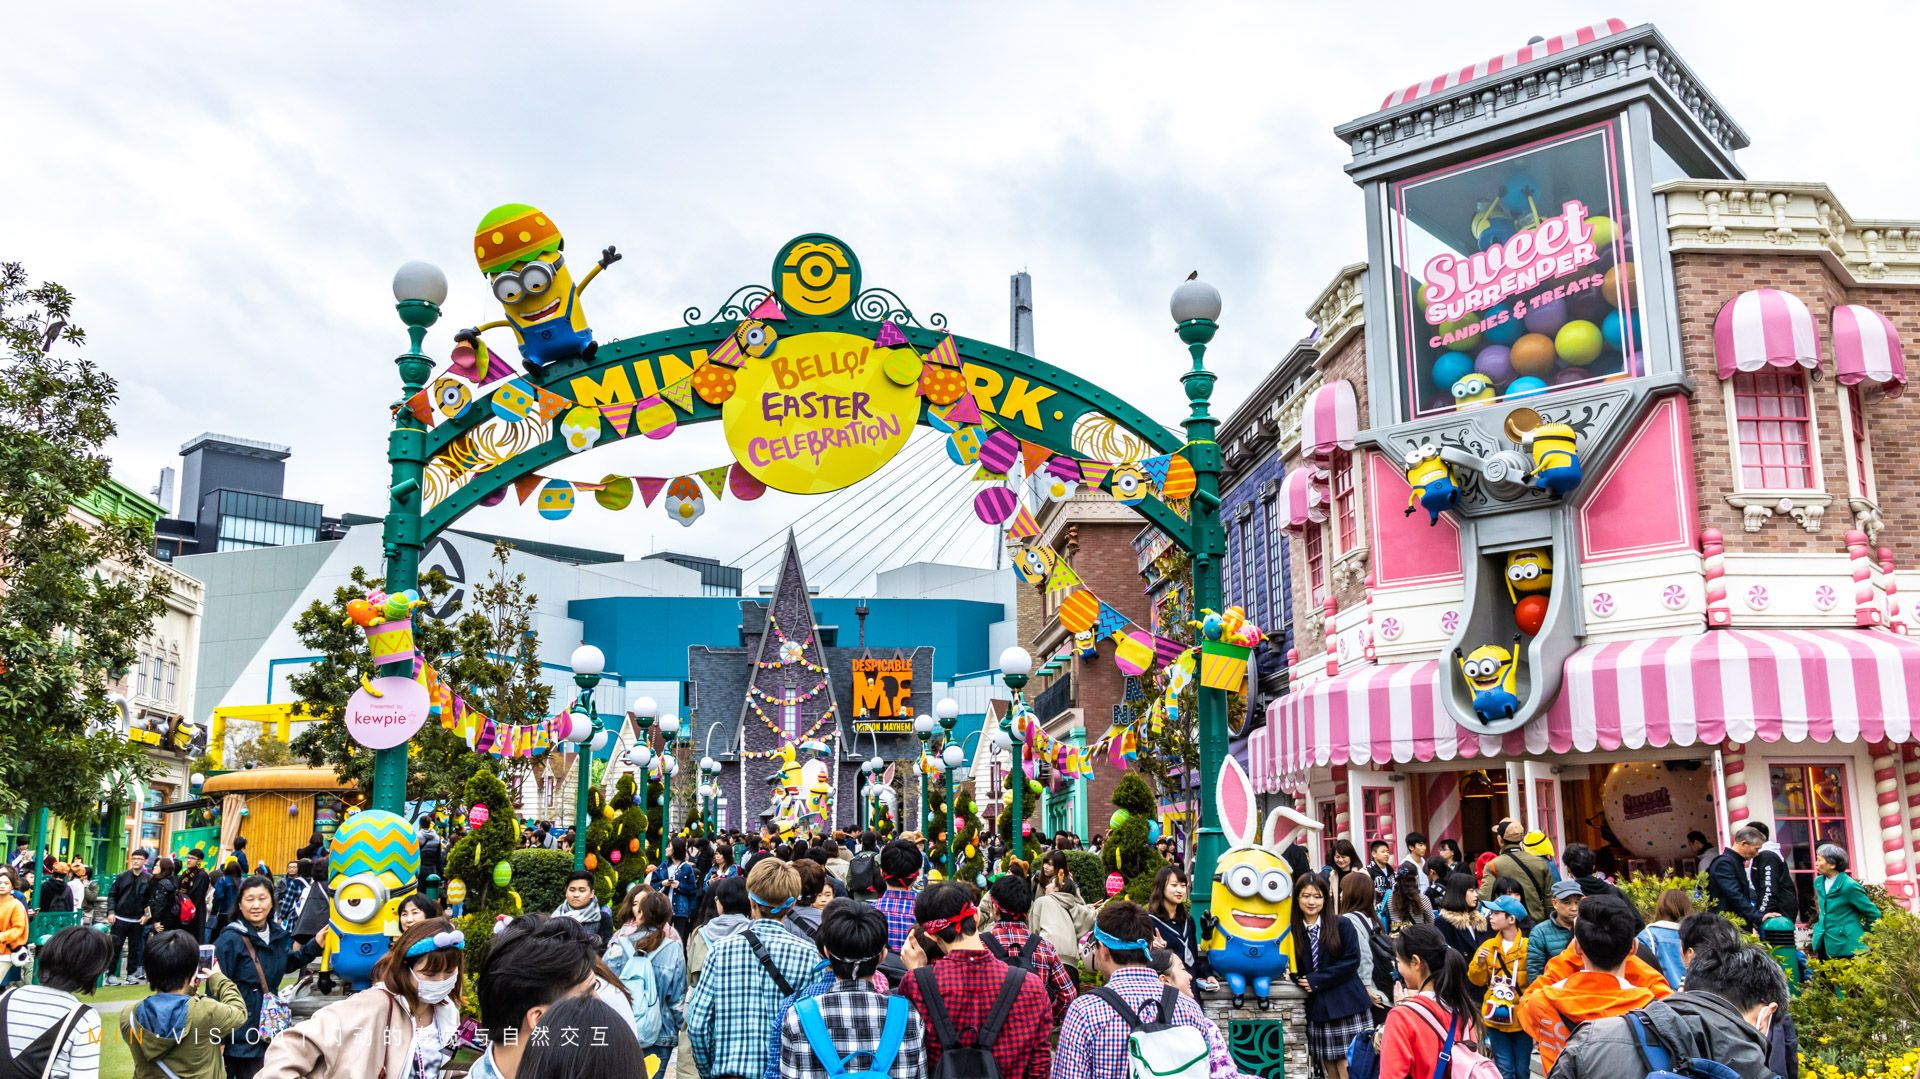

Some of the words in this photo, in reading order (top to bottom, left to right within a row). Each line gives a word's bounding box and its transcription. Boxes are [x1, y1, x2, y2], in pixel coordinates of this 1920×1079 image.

[1425, 201, 1593, 304] Sweet
[1427, 242, 1597, 323] SURRENDER
[1429, 309, 1509, 348] CANDIES
[1513, 300, 1527, 320] &
[1529, 273, 1605, 310] TREATS
[570, 348, 710, 416] MIN
[770, 346, 870, 390] BELLO!
[761, 391, 874, 427] EASTER
[747, 413, 901, 468] CELEBRATION
[852, 658, 913, 671] DESPICABLE
[853, 671, 914, 717] ME
[355, 711, 406, 728] kewpie
[882, 722, 911, 732] MAYHEM
